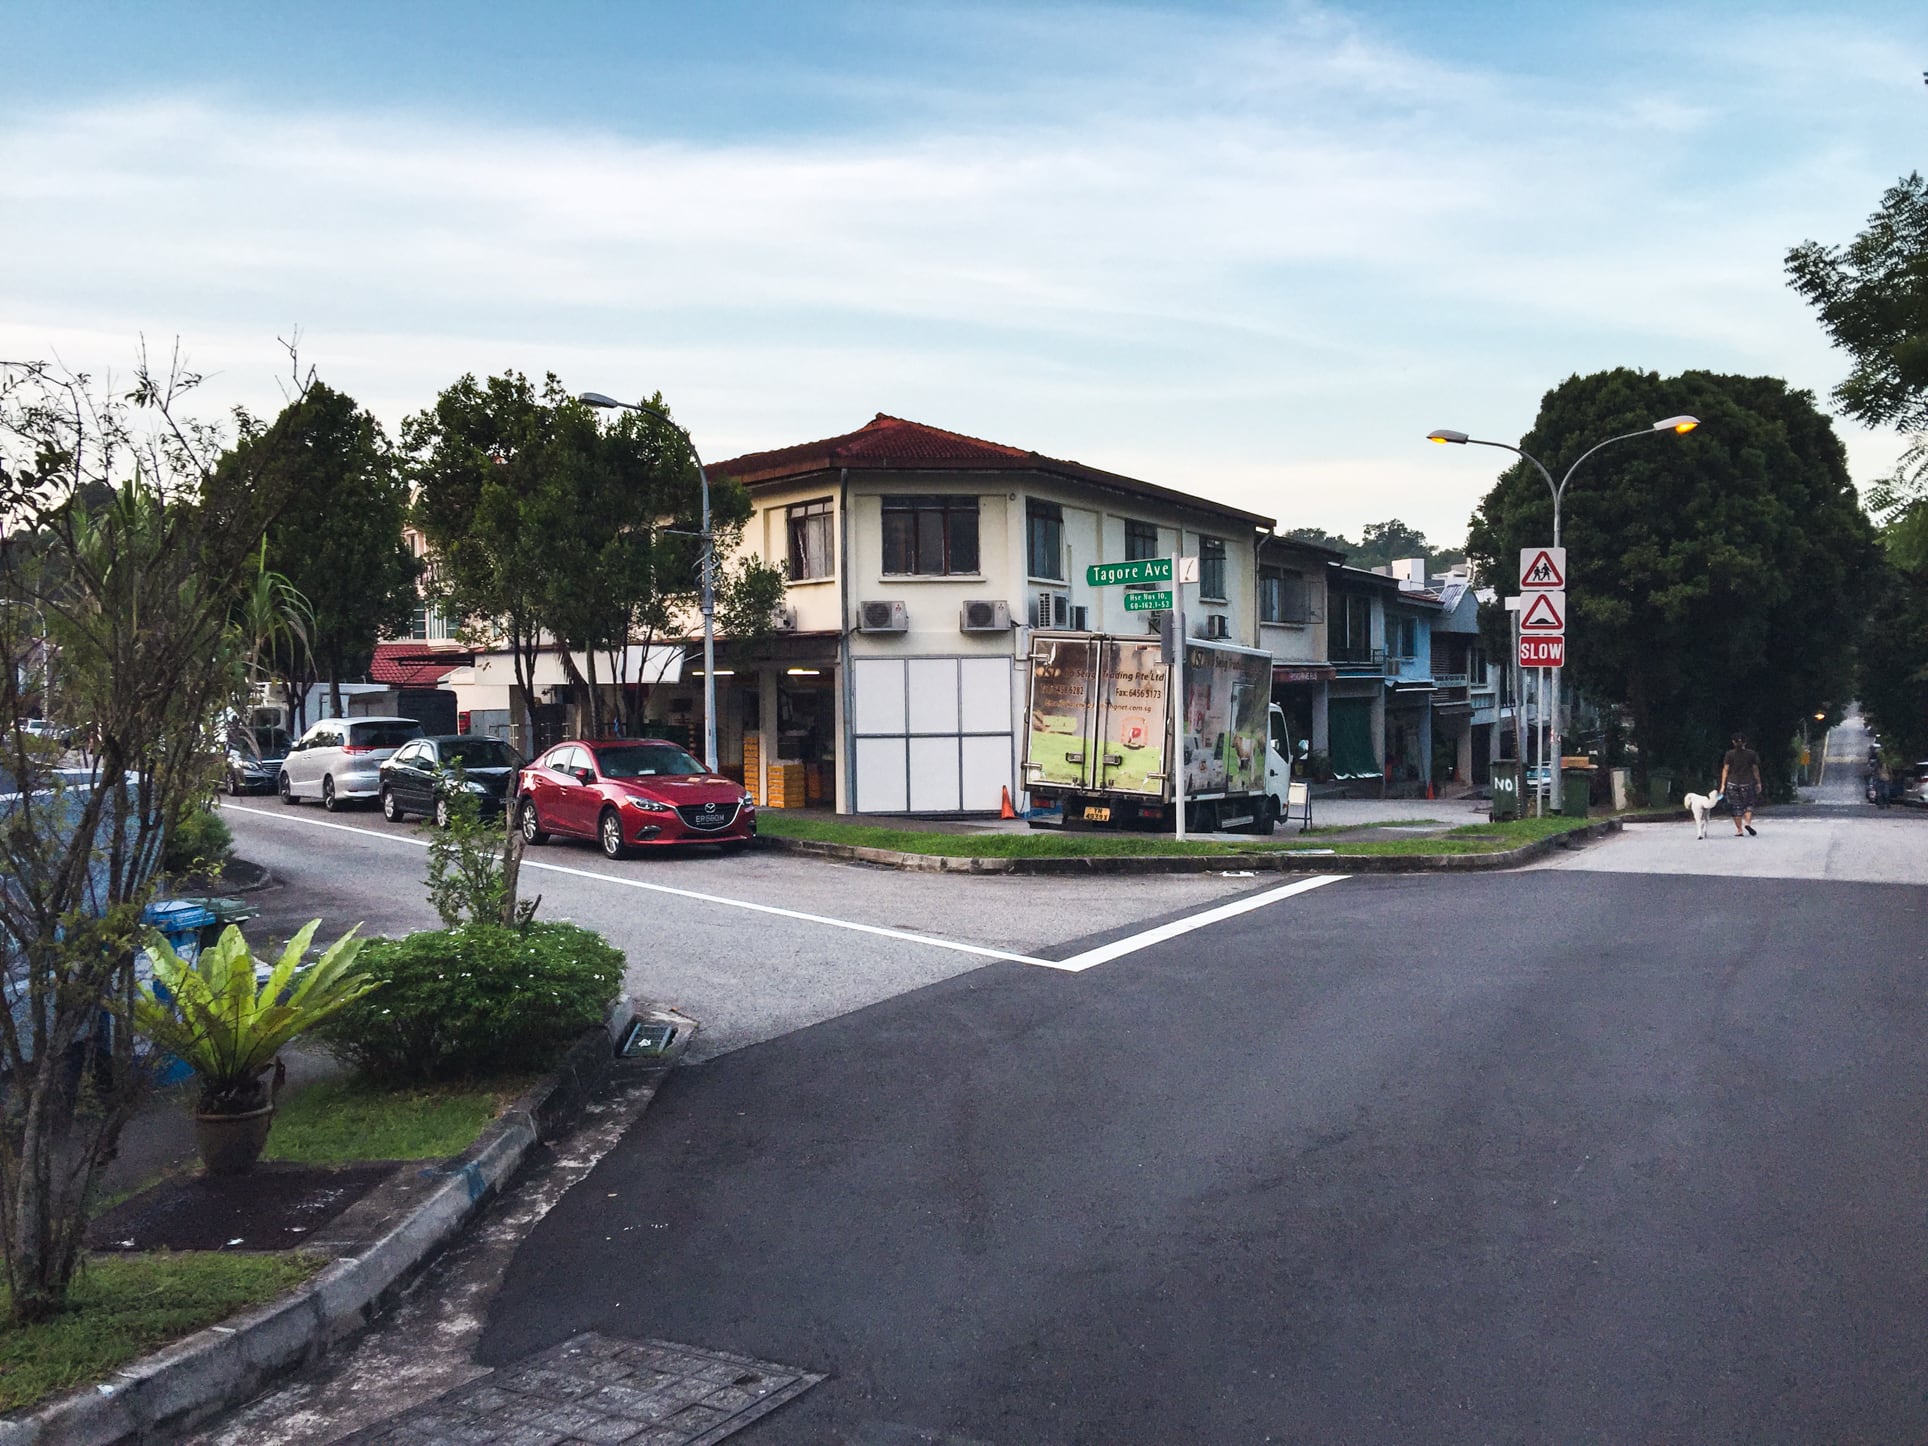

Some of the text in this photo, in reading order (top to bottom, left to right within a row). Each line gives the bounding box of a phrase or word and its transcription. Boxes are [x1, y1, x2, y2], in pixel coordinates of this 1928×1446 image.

[1093, 562, 1169, 584] Tagore Ave
[1129, 593, 1142, 601] Hse
[1143, 592, 1155, 600] Nos
[1520, 642, 1562, 660] SLOW
[1102, 670, 1133, 682] Trading
[1135, 671, 1150, 681] Pte
[1150, 671, 1165, 682] Ltd
[1494, 777, 1513, 792] NO
